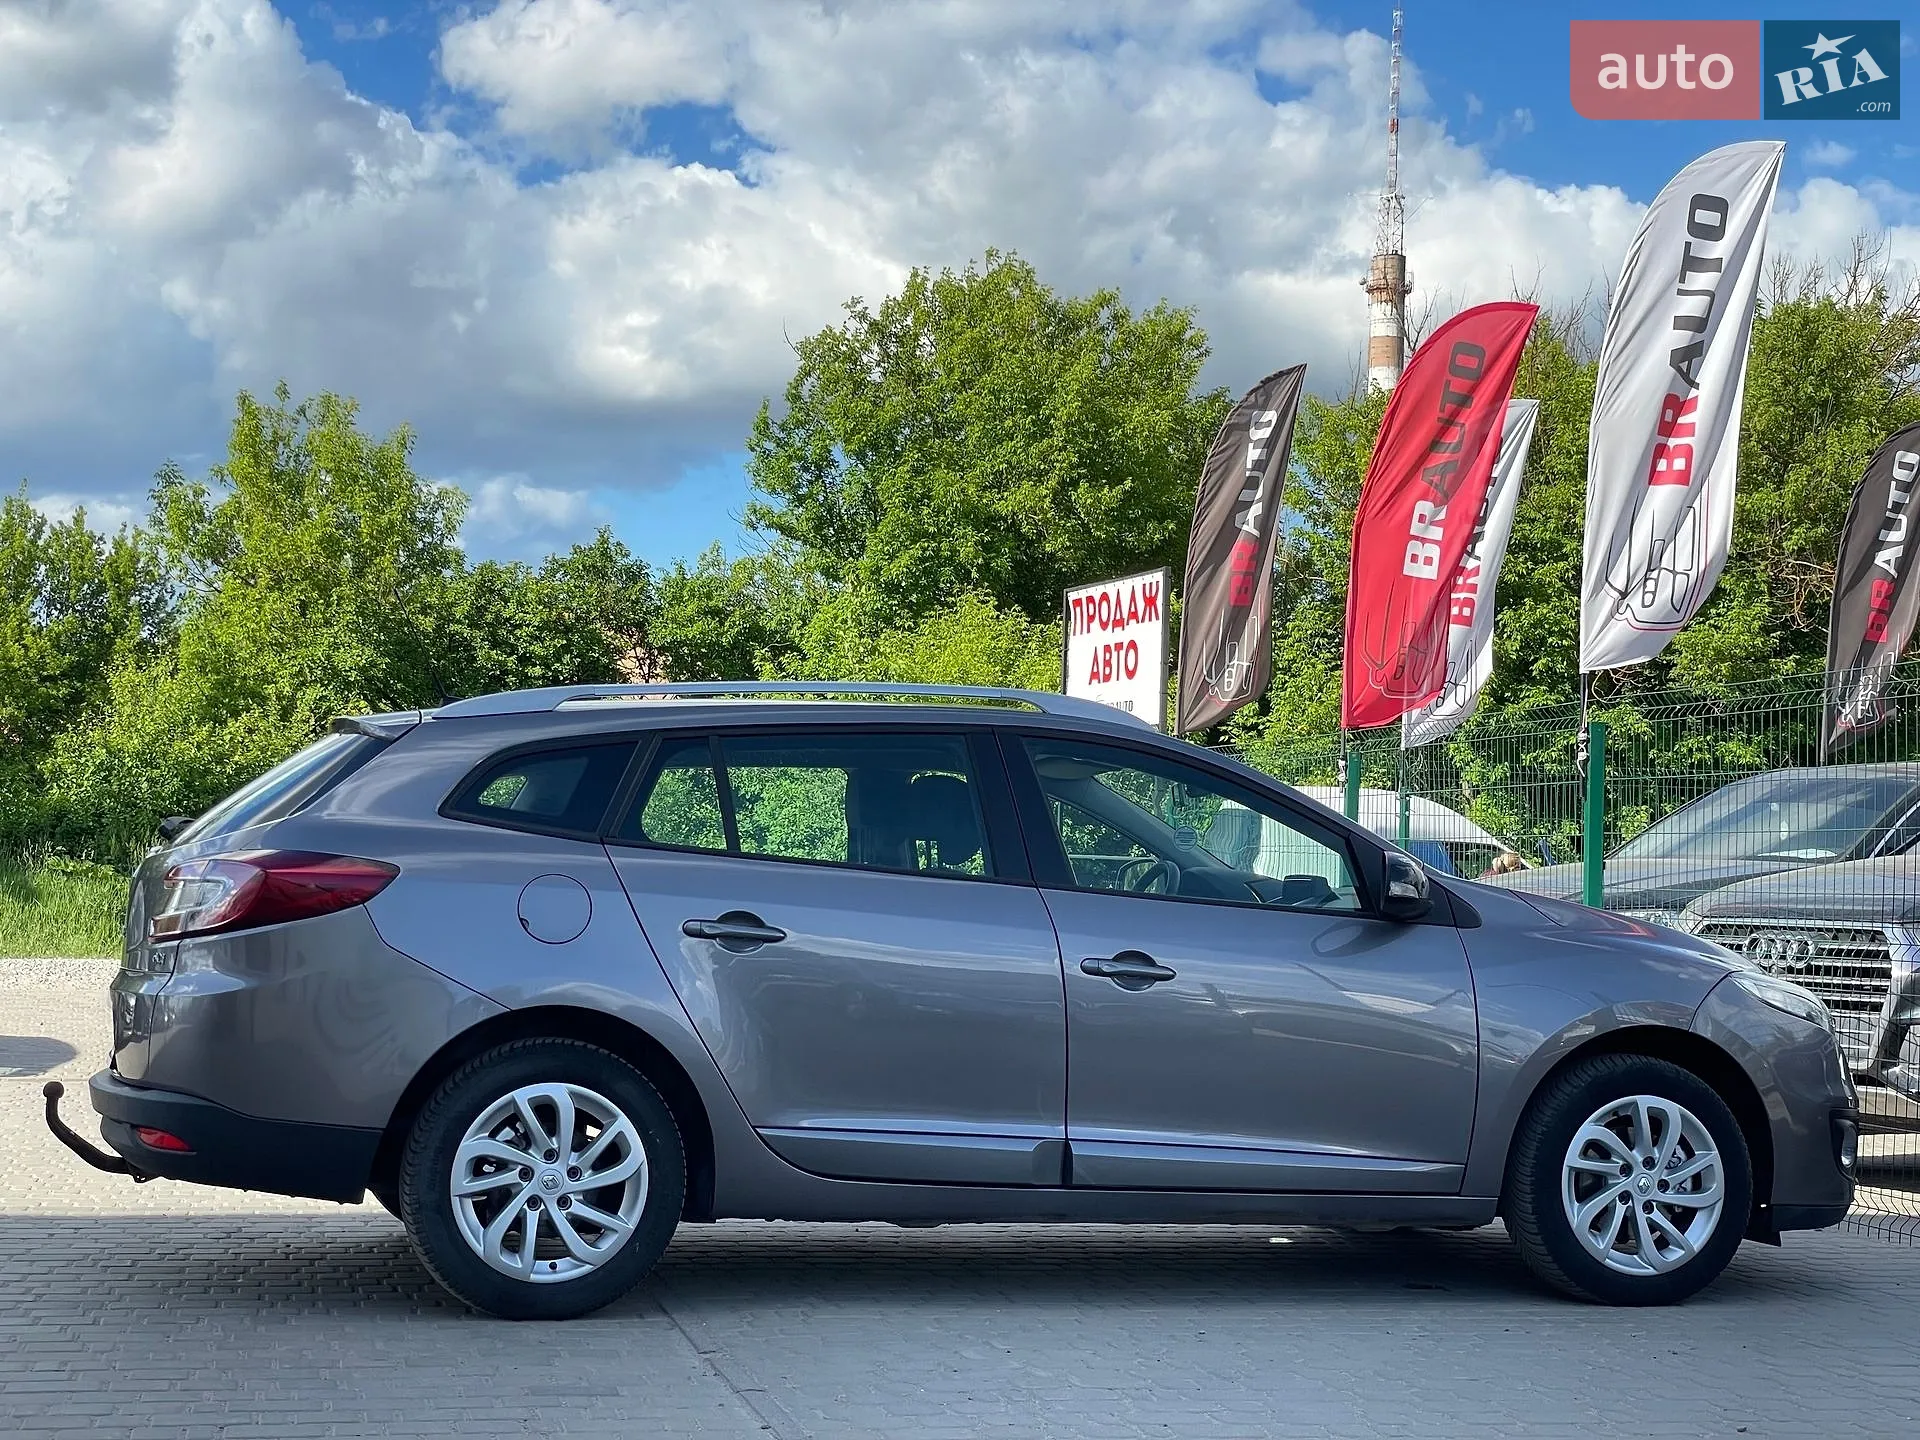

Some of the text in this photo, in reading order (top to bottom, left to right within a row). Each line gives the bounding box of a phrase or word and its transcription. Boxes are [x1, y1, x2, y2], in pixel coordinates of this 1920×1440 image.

[1648, 193, 1731, 488] BRAUTO
[1229, 409, 1279, 607] BRAUTO
[1403, 341, 1487, 581] BRAUTO
[1865, 450, 1920, 644] BRAUTO
[1072, 580, 1160, 636] ПРОДАЖ
[1089, 639, 1139, 686] АВТО
